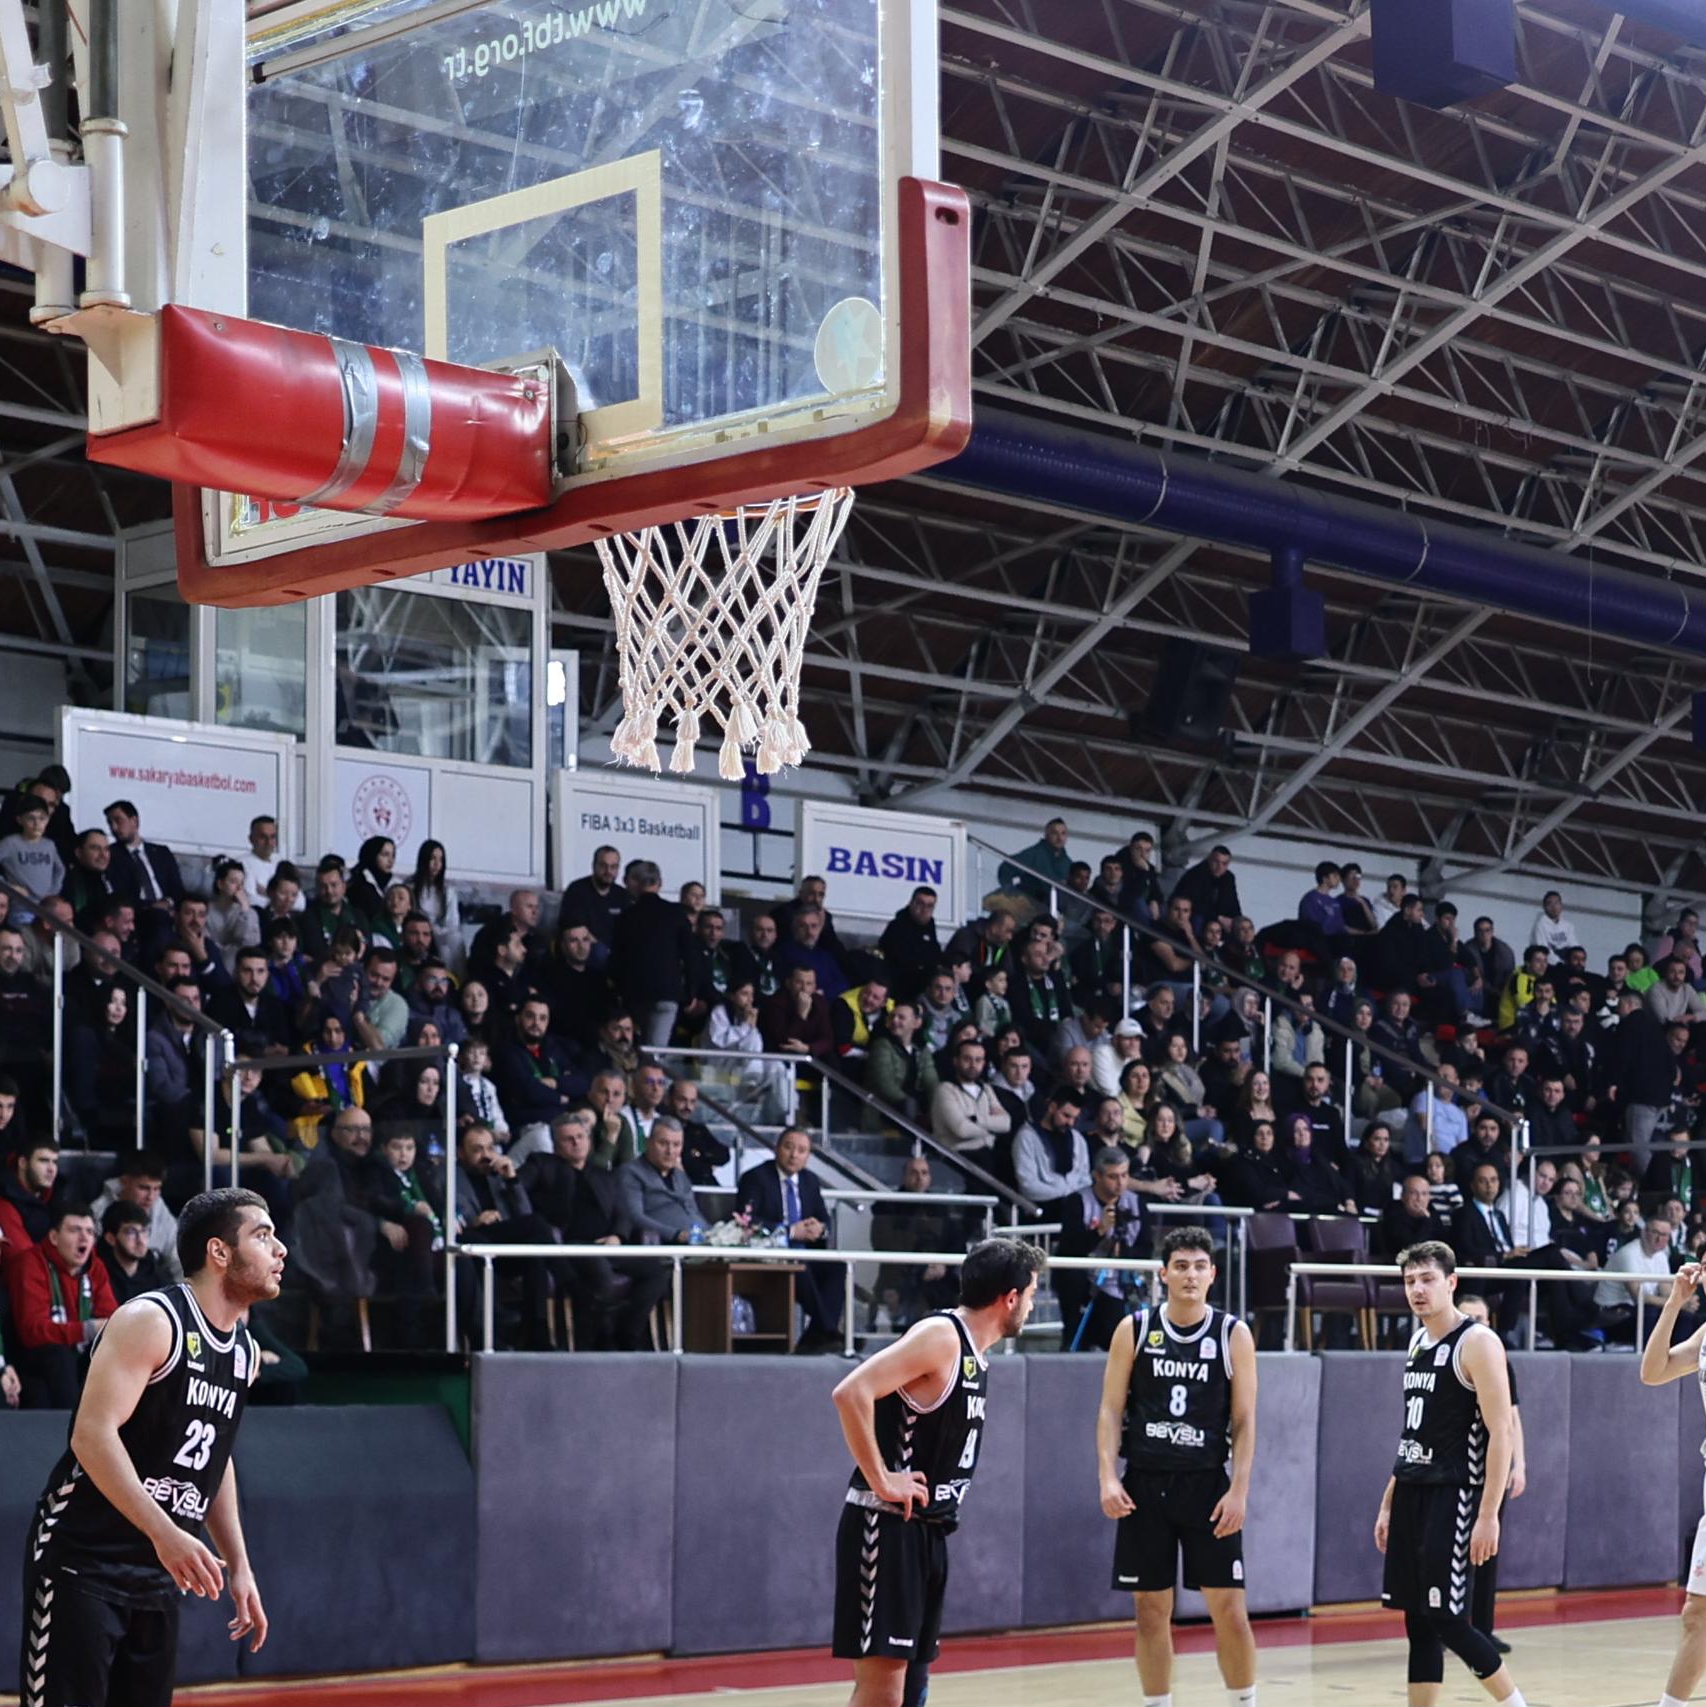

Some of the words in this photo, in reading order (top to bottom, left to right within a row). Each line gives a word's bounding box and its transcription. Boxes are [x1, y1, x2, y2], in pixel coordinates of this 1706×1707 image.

[108, 764, 257, 793] www.sakaryabasketbol.com
[581, 813, 611, 831] FIBA
[614, 816, 635, 833] 3x3
[638, 818, 700, 840] Basketball
[827, 847, 944, 884] BASIN
[1153, 1358, 1208, 1382] KONYA
[1403, 1371, 1436, 1392] KONYA
[186, 1376, 237, 1419] KONYA
[1169, 1384, 1188, 1417] 8
[1406, 1396, 1424, 1430] 10
[173, 1418, 216, 1471] 23
